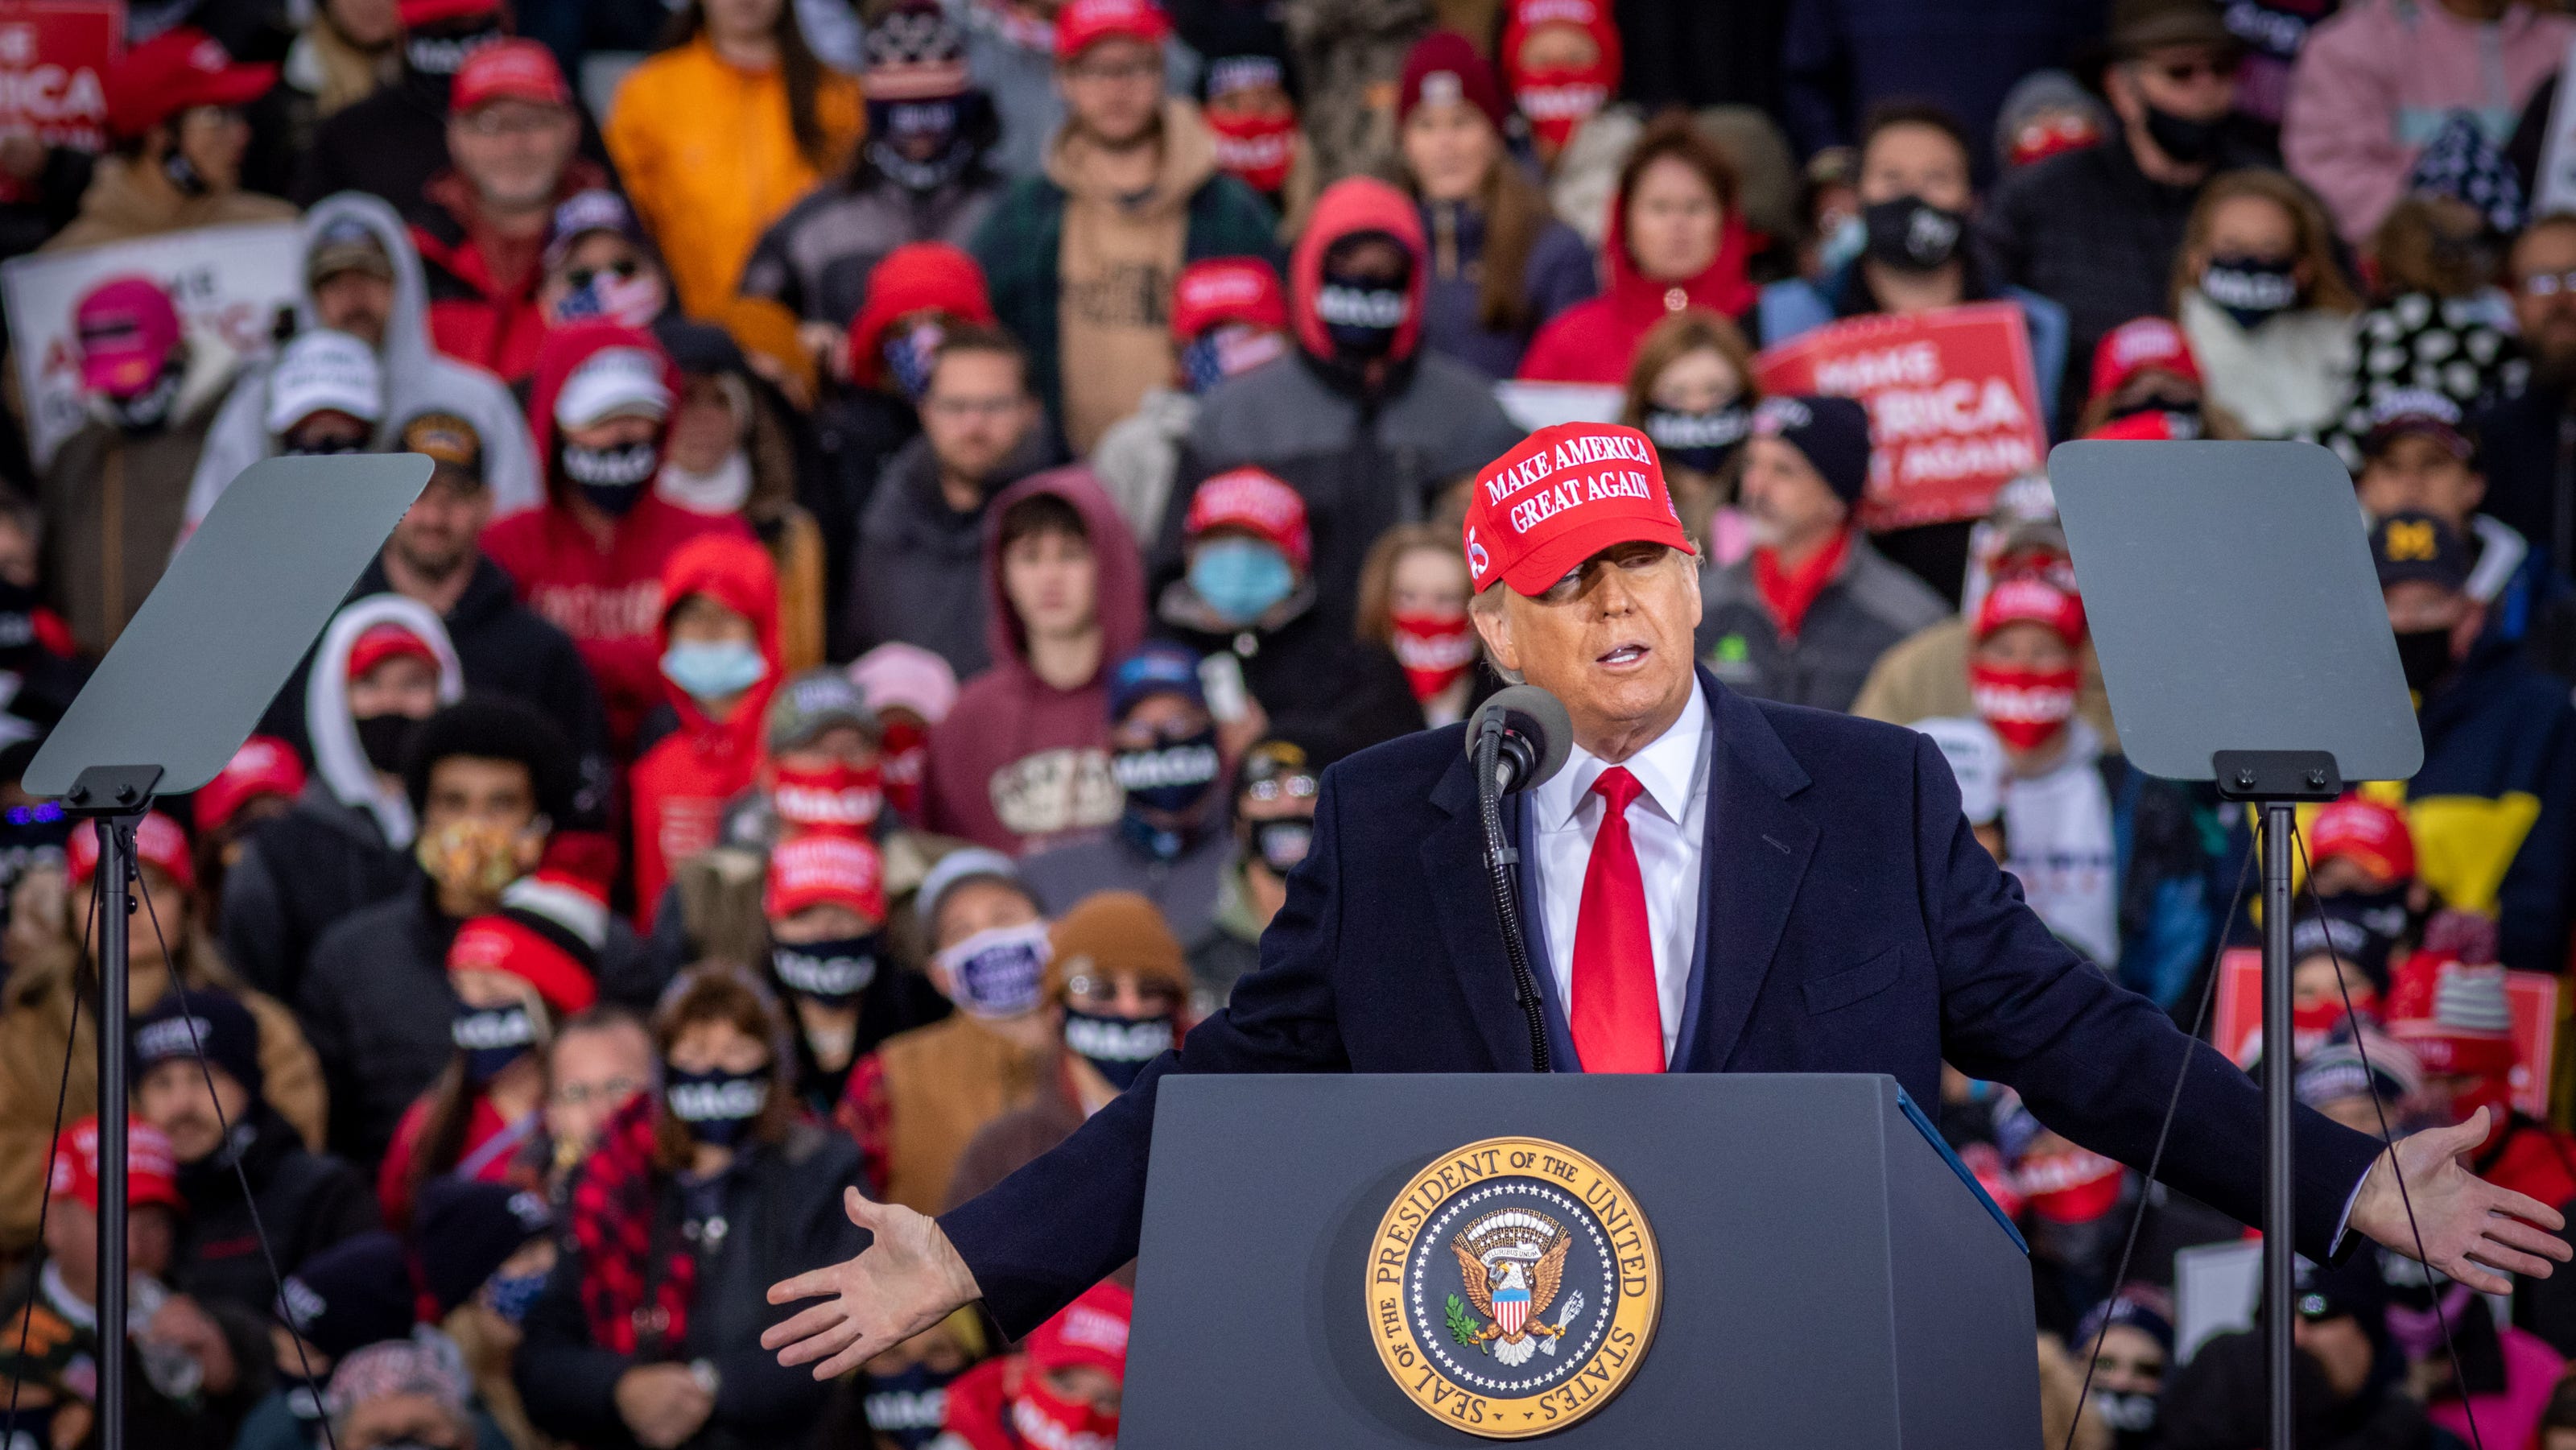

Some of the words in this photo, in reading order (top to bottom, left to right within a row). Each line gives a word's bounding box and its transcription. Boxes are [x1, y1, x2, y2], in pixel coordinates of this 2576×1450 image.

[1814, 341, 1940, 395] MAKE
[1485, 452, 1552, 506] MAKE
[1555, 436, 1652, 470] AMERICA
[1509, 479, 1583, 534] GREAT
[1587, 470, 1652, 501] AGAIN
[1510, 1151, 1536, 1168] OF
[1543, 1155, 1578, 1183] THE
[1377, 1149, 1500, 1285] PRESIDENT
[1586, 1178, 1646, 1297] UNITED
[1487, 1249, 1518, 1258] PLURIBUS
[1381, 1298, 1399, 1338] THE
[1392, 1343, 1414, 1367] OF
[1539, 1328, 1635, 1420] STATES
[865, 1390, 945, 1431] MAG
[1414, 1365, 1487, 1423] SEAL
